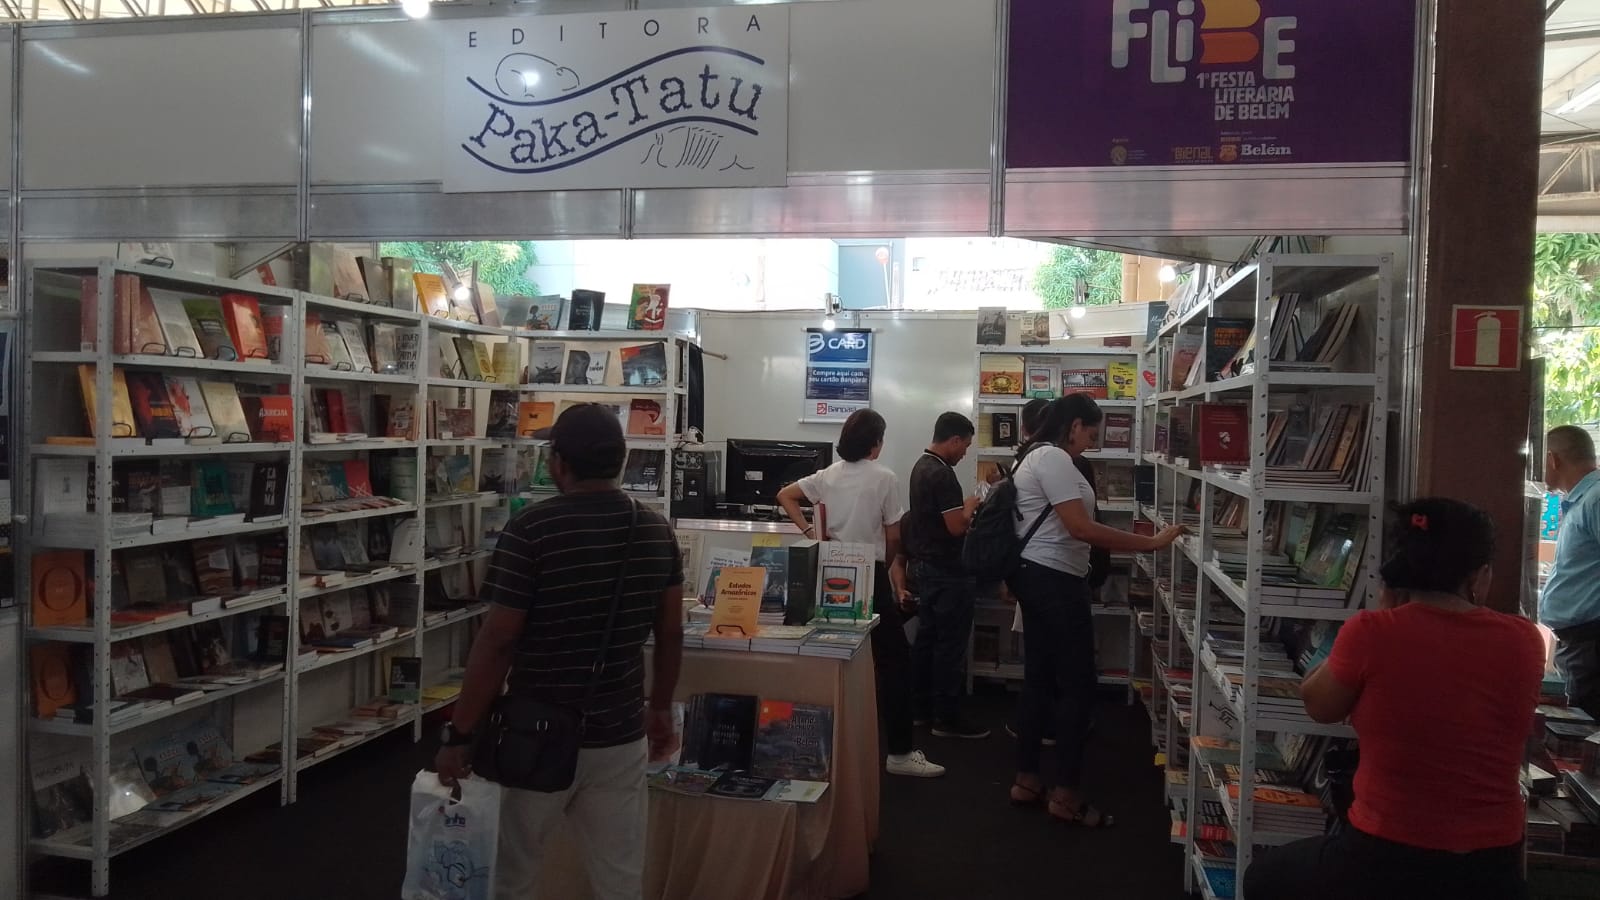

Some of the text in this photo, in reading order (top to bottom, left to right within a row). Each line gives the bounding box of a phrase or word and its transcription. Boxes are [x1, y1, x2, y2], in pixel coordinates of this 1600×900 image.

[469, 15, 761, 48] EDITORA
[1211, 71, 1256, 88] FESTA
[1215, 85, 1295, 104] LITERÁRIA
[469, 64, 762, 164] Paka-Tatu
[1215, 102, 1289, 121] DE BELÉM
[1240, 143, 1292, 156] Belém
[828, 338, 866, 350] CARD
